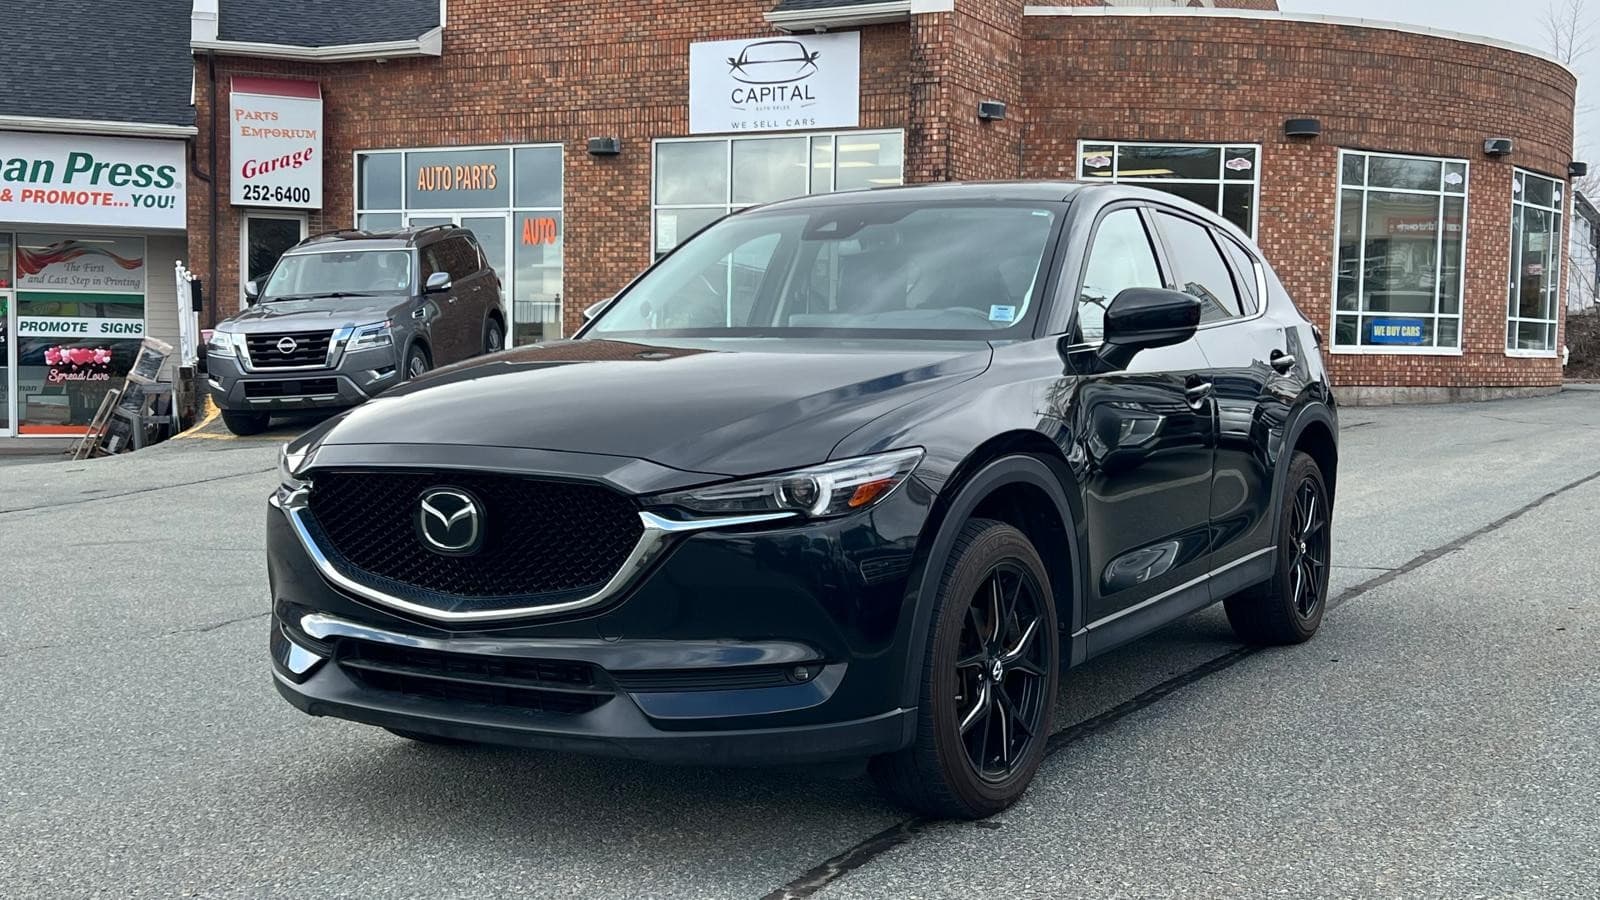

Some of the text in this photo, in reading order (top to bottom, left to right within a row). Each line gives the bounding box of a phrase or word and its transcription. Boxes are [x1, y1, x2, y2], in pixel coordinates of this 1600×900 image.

[731, 85, 815, 104] CAPITAL
[731, 118, 816, 129] WE SELL CARS
[0, 151, 177, 189] an Press
[242, 147, 313, 179] Garage
[417, 163, 497, 191] AUTO PARTS
[0, 188, 13, 203] &
[243, 184, 310, 203] 252-6400
[522, 217, 557, 245] AUTO
[64, 262, 105, 273] The First
[27, 273, 141, 289] and Last Step in Printing
[19, 321, 88, 333] PROMOTE
[100, 322, 143, 334] SIGNS
[1374, 325, 1421, 337] WE BUY CARS
[48, 368, 110, 382] Spread Love
